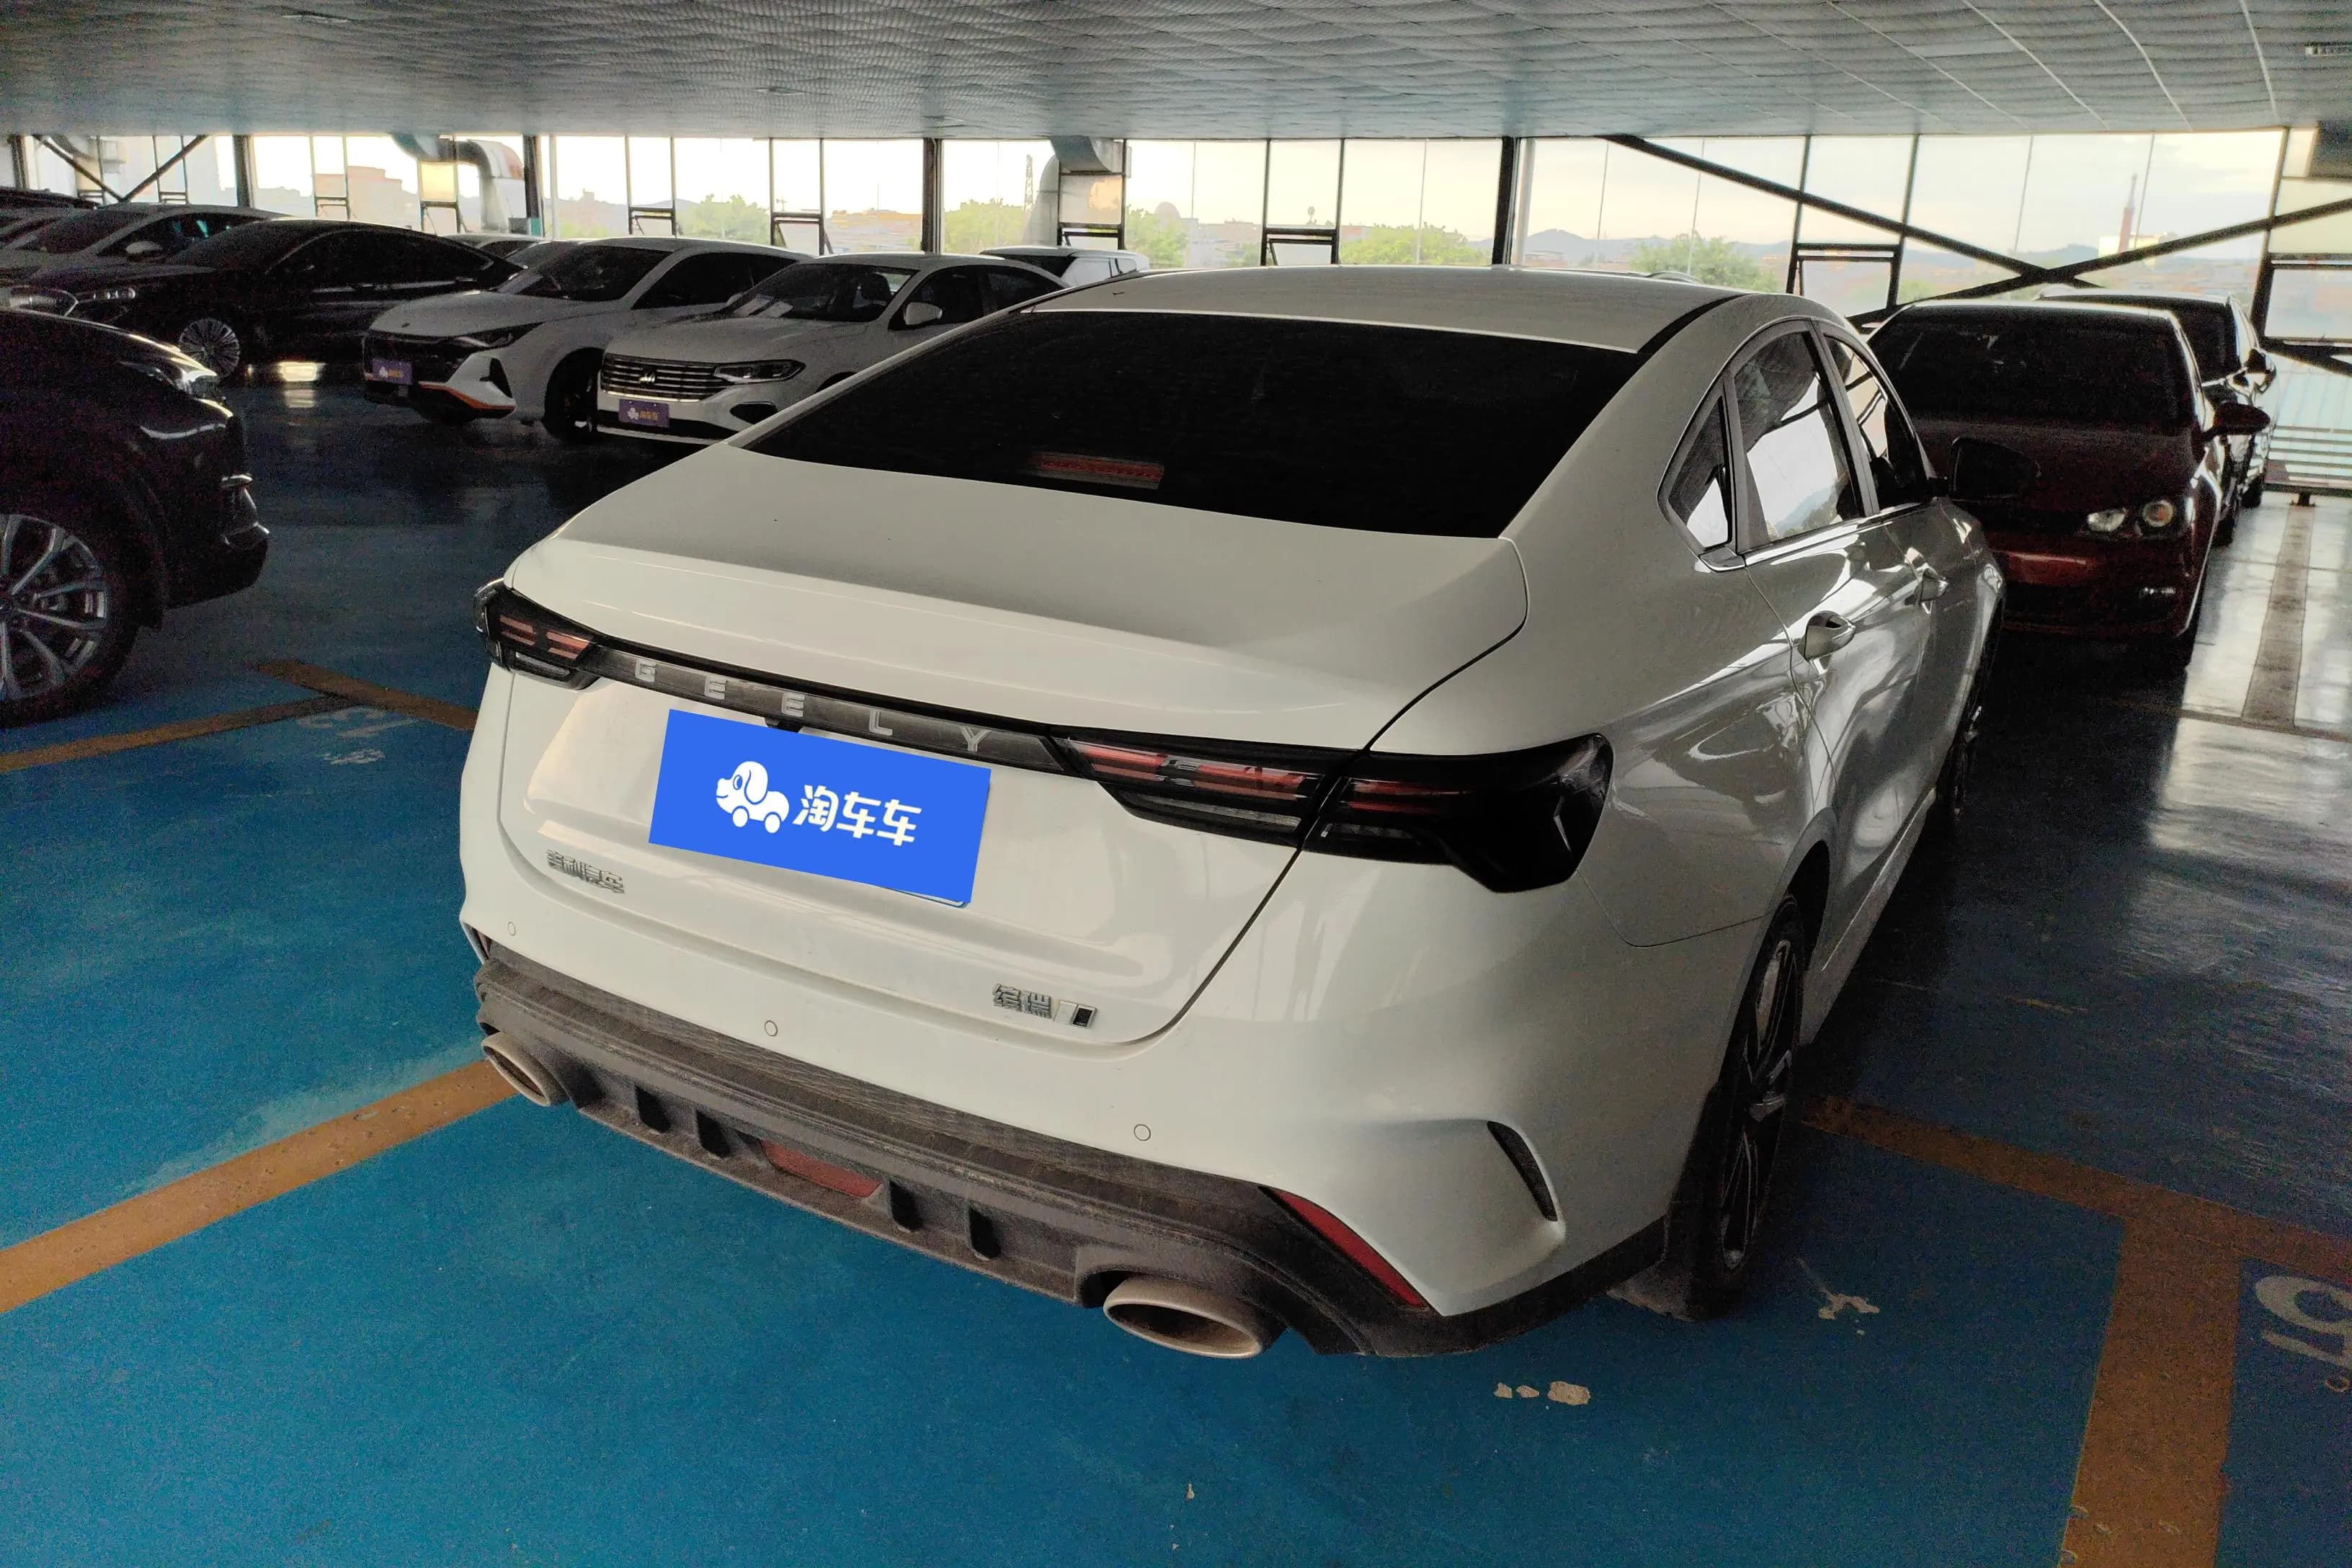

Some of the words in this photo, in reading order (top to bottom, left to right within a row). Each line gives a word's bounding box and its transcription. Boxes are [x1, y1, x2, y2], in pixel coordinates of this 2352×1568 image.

[635, 658, 991, 753] GEELY
[547, 850, 625, 894] 吉利汽车
